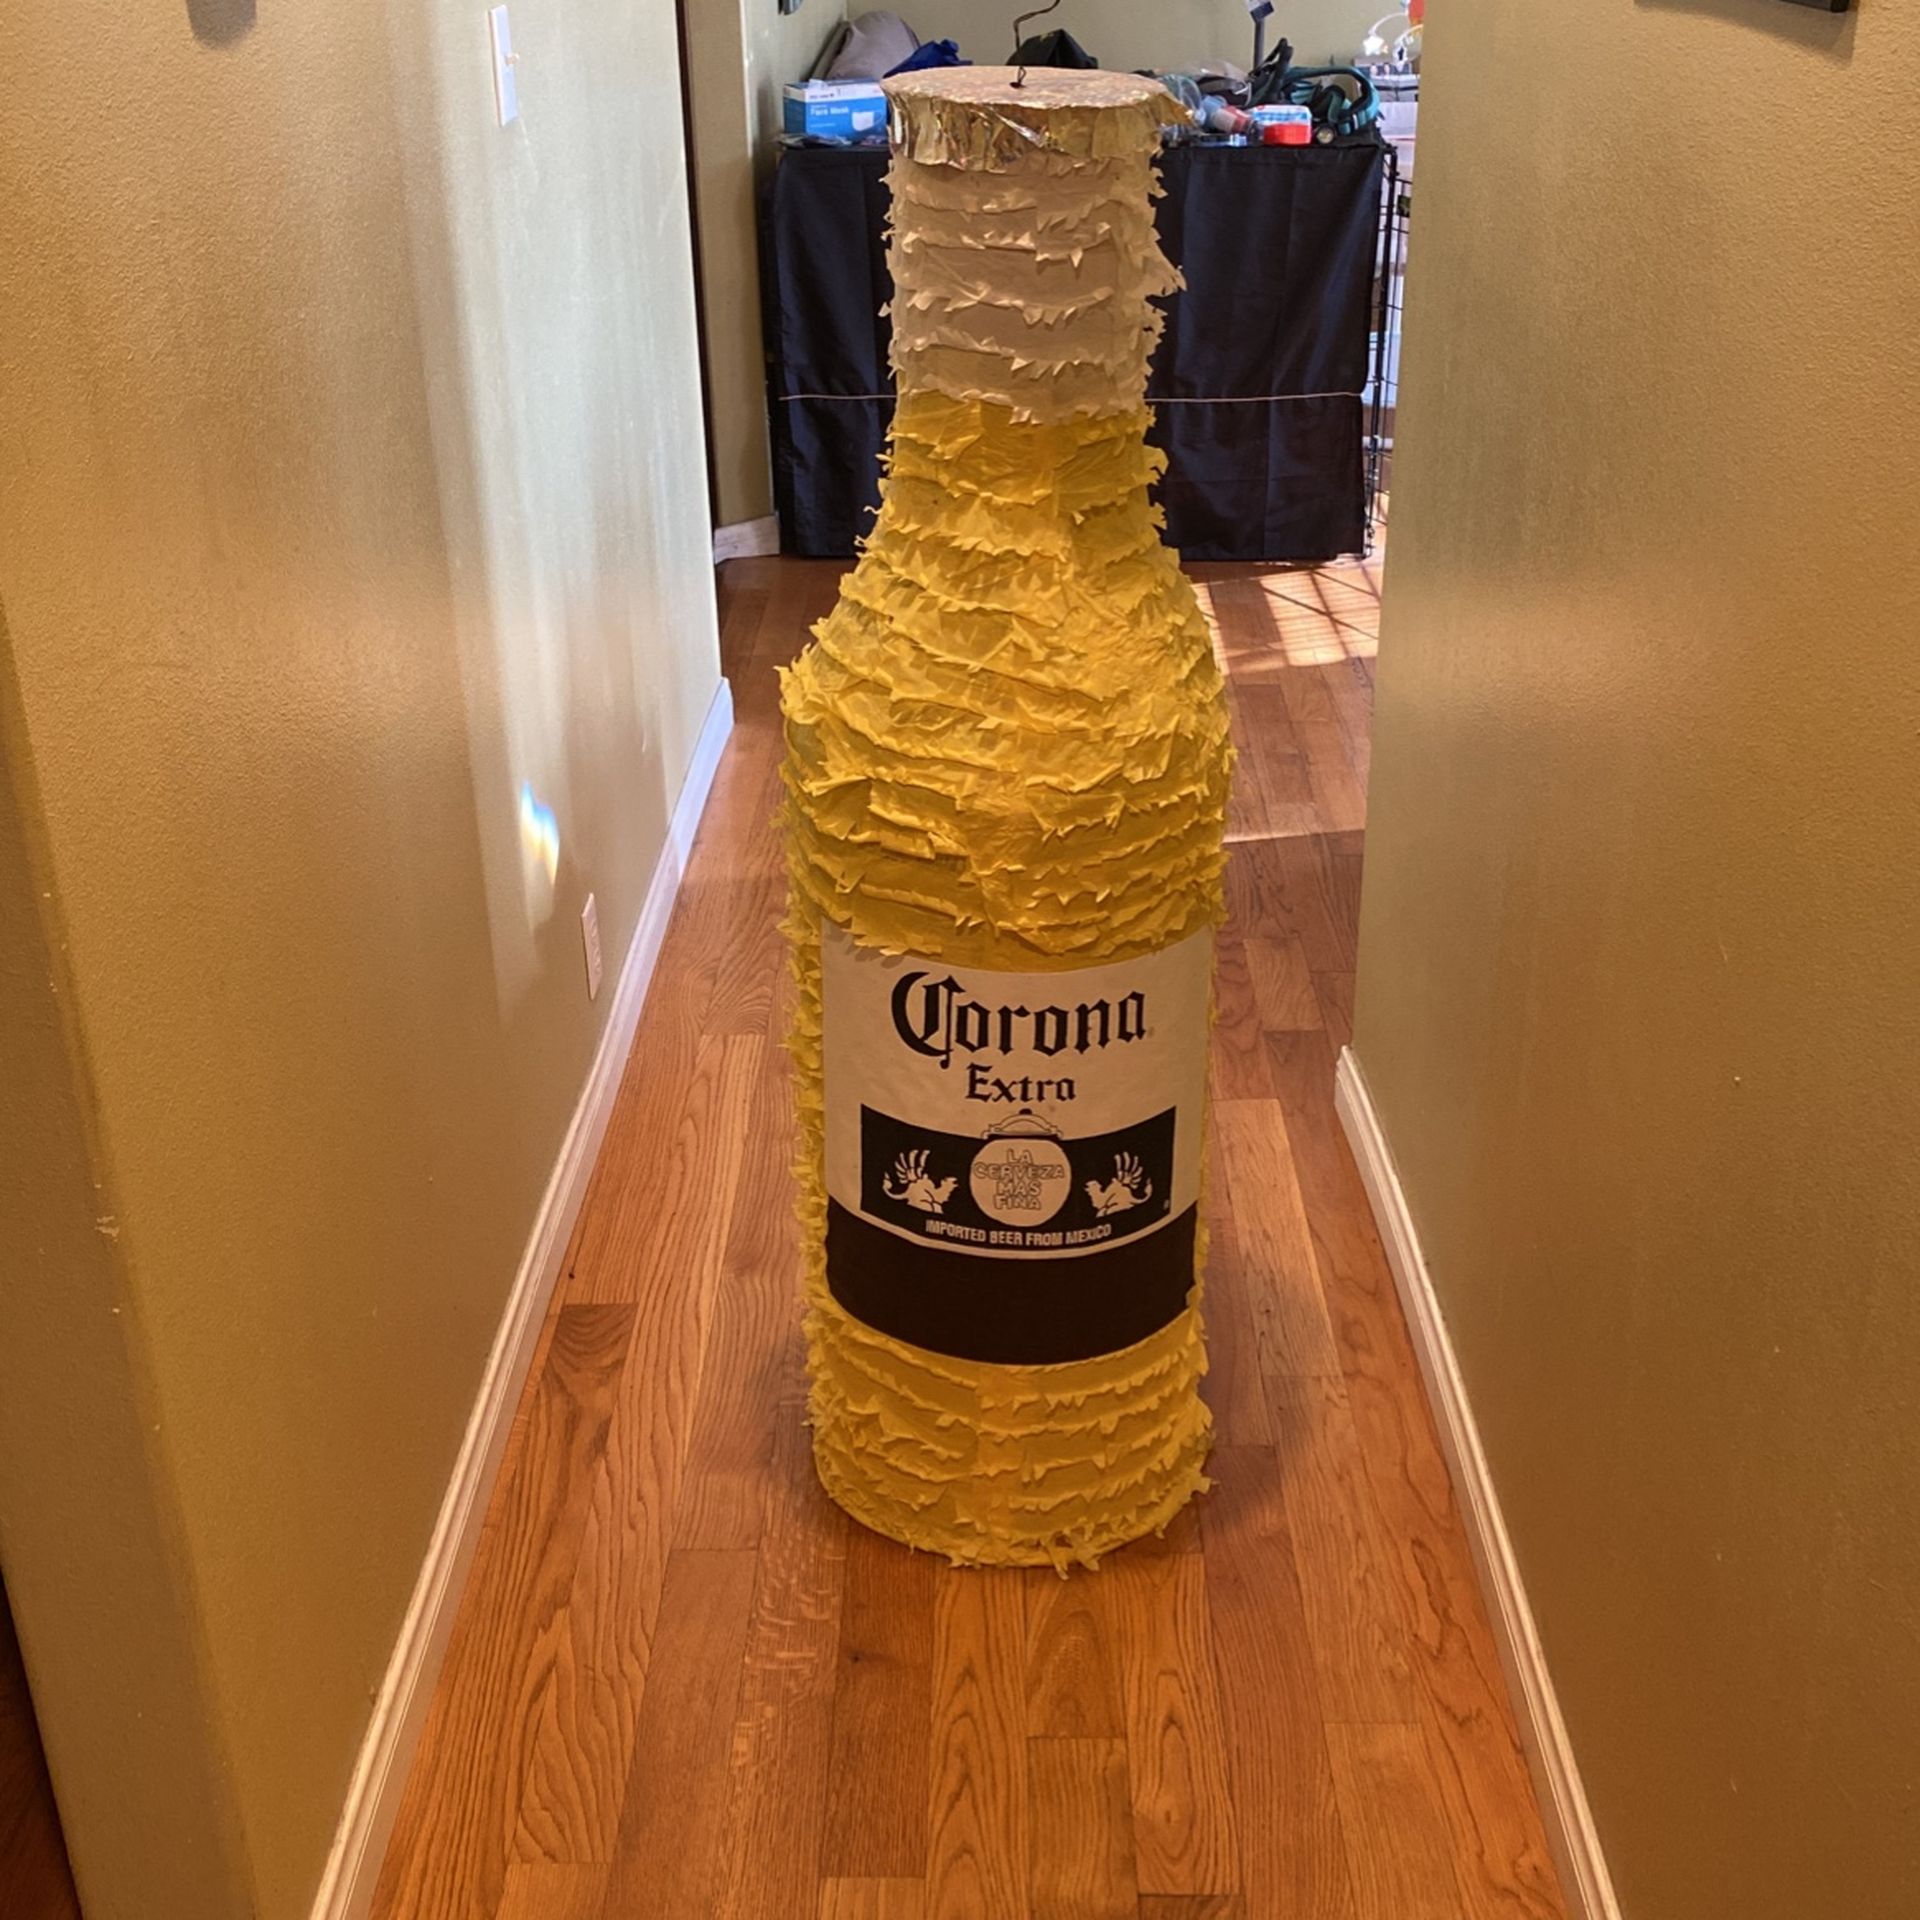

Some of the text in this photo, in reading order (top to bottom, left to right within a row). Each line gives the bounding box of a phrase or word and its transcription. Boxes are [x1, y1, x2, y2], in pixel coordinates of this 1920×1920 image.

[891, 971, 1146, 1069] Corona
[965, 1063, 1076, 1103] Extra
[1006, 1148, 1033, 1165] LA
[974, 1161, 1065, 1180] CERVEZA
[993, 1194, 1042, 1210] FINA
[925, 1219, 1112, 1246] IMPORTED BEER FROM MEXICO
